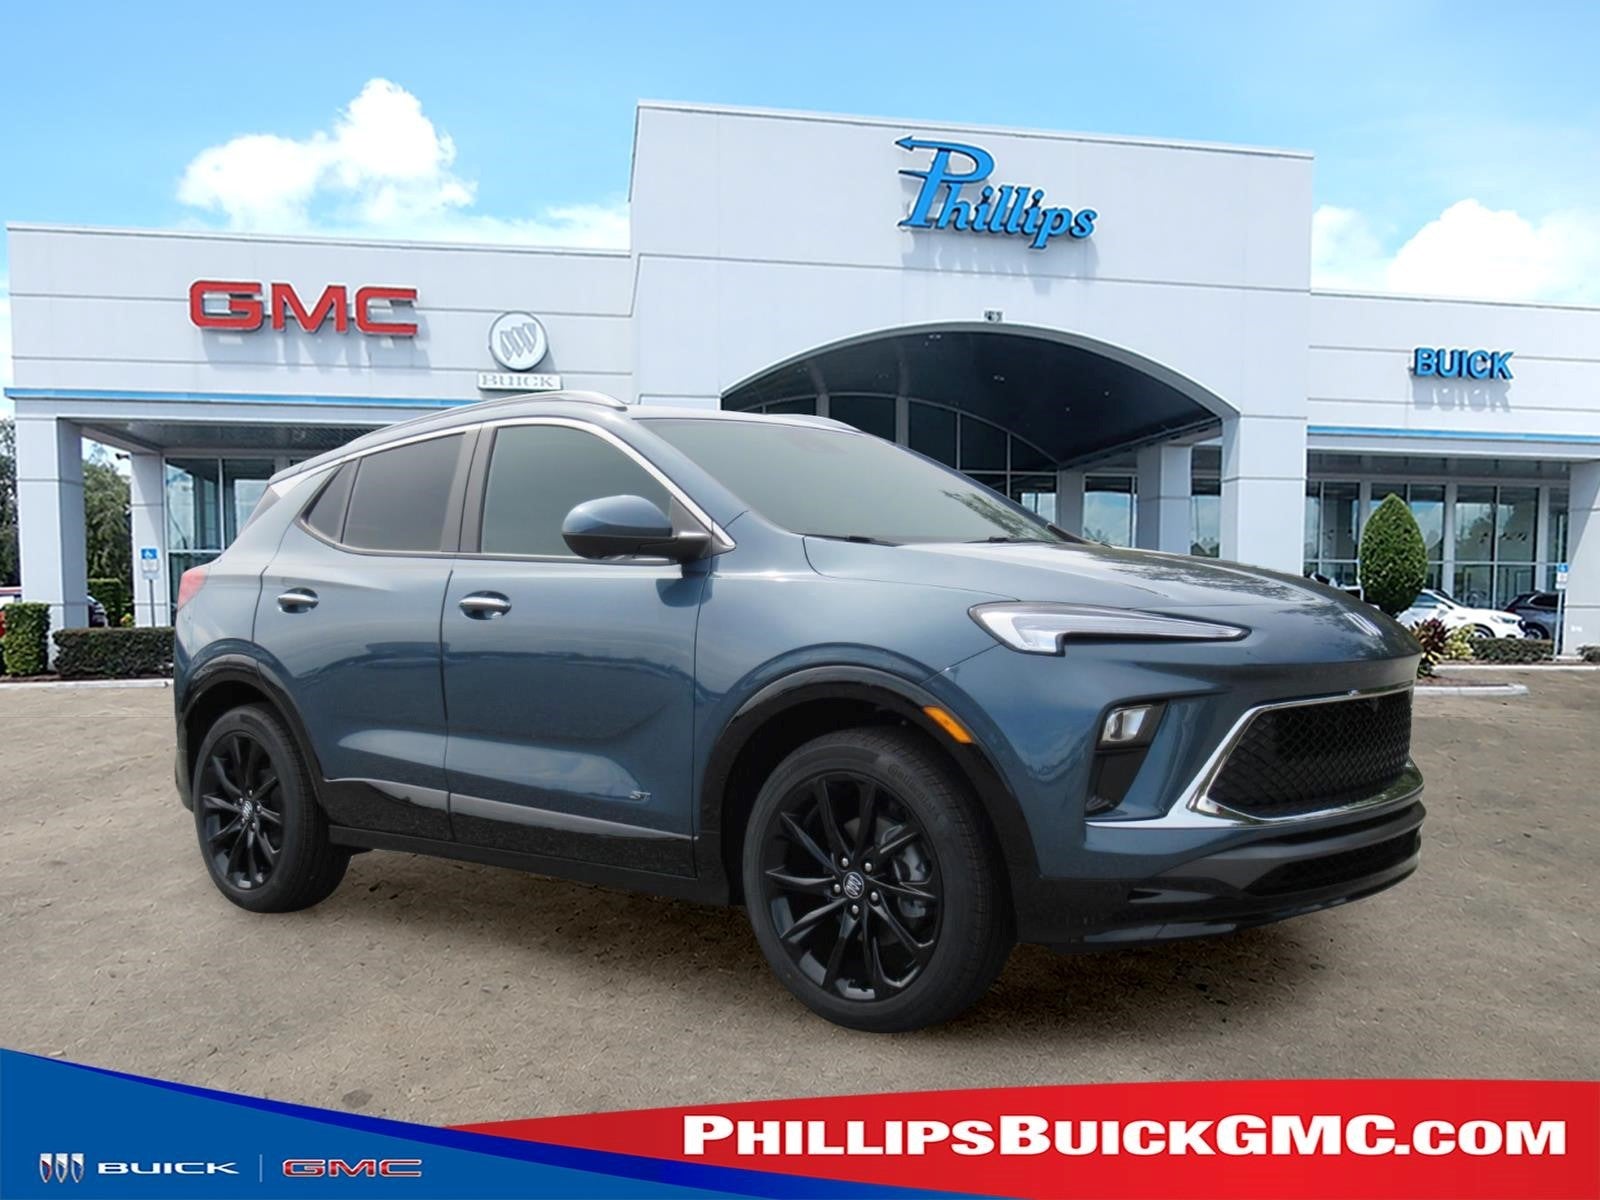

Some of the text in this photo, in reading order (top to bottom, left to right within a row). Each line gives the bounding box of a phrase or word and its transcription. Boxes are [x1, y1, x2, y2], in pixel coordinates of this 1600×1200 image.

[895, 136, 1098, 249] Phillips
[189, 279, 418, 336] GMC
[482, 375, 555, 388] BUICK
[1414, 347, 1514, 380] BUICK
